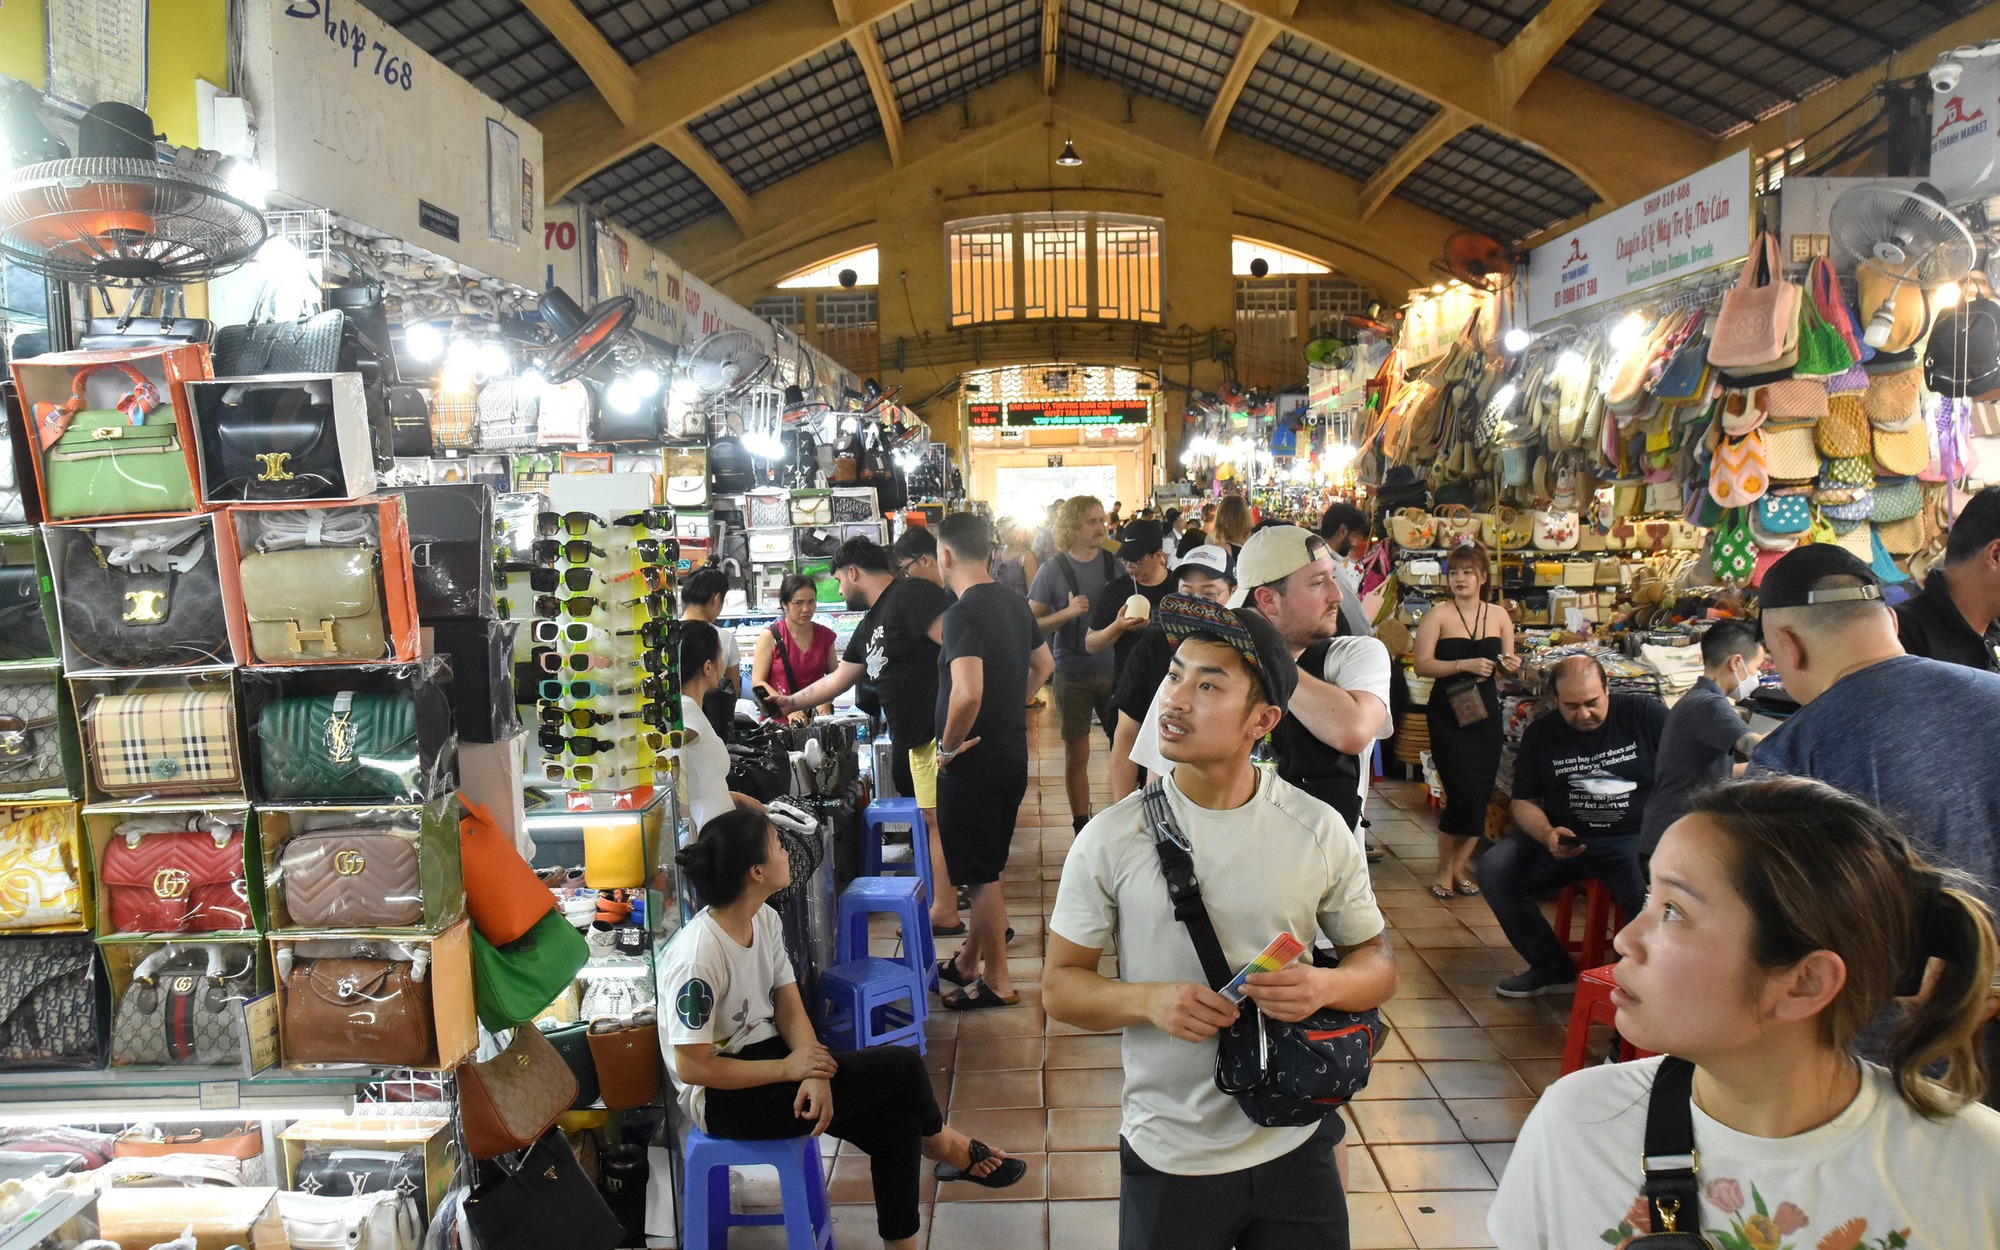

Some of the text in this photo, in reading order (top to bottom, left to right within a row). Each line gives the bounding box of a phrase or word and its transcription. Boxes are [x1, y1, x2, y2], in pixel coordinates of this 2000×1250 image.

[373, 41, 412, 91] 768
[1961, 119, 1987, 140] MARKET
[1643, 196, 1660, 216] SHOP
[685, 287, 701, 318] SHOP
[1578, 756, 1590, 764] buy
[1591, 752, 1606, 761] other
[1607, 747, 1624, 757] shoes
[1625, 741, 1637, 752] and
[1555, 765, 1578, 776] pretend
[1579, 763, 1600, 772] they're
[1569, 801, 1583, 809] your
